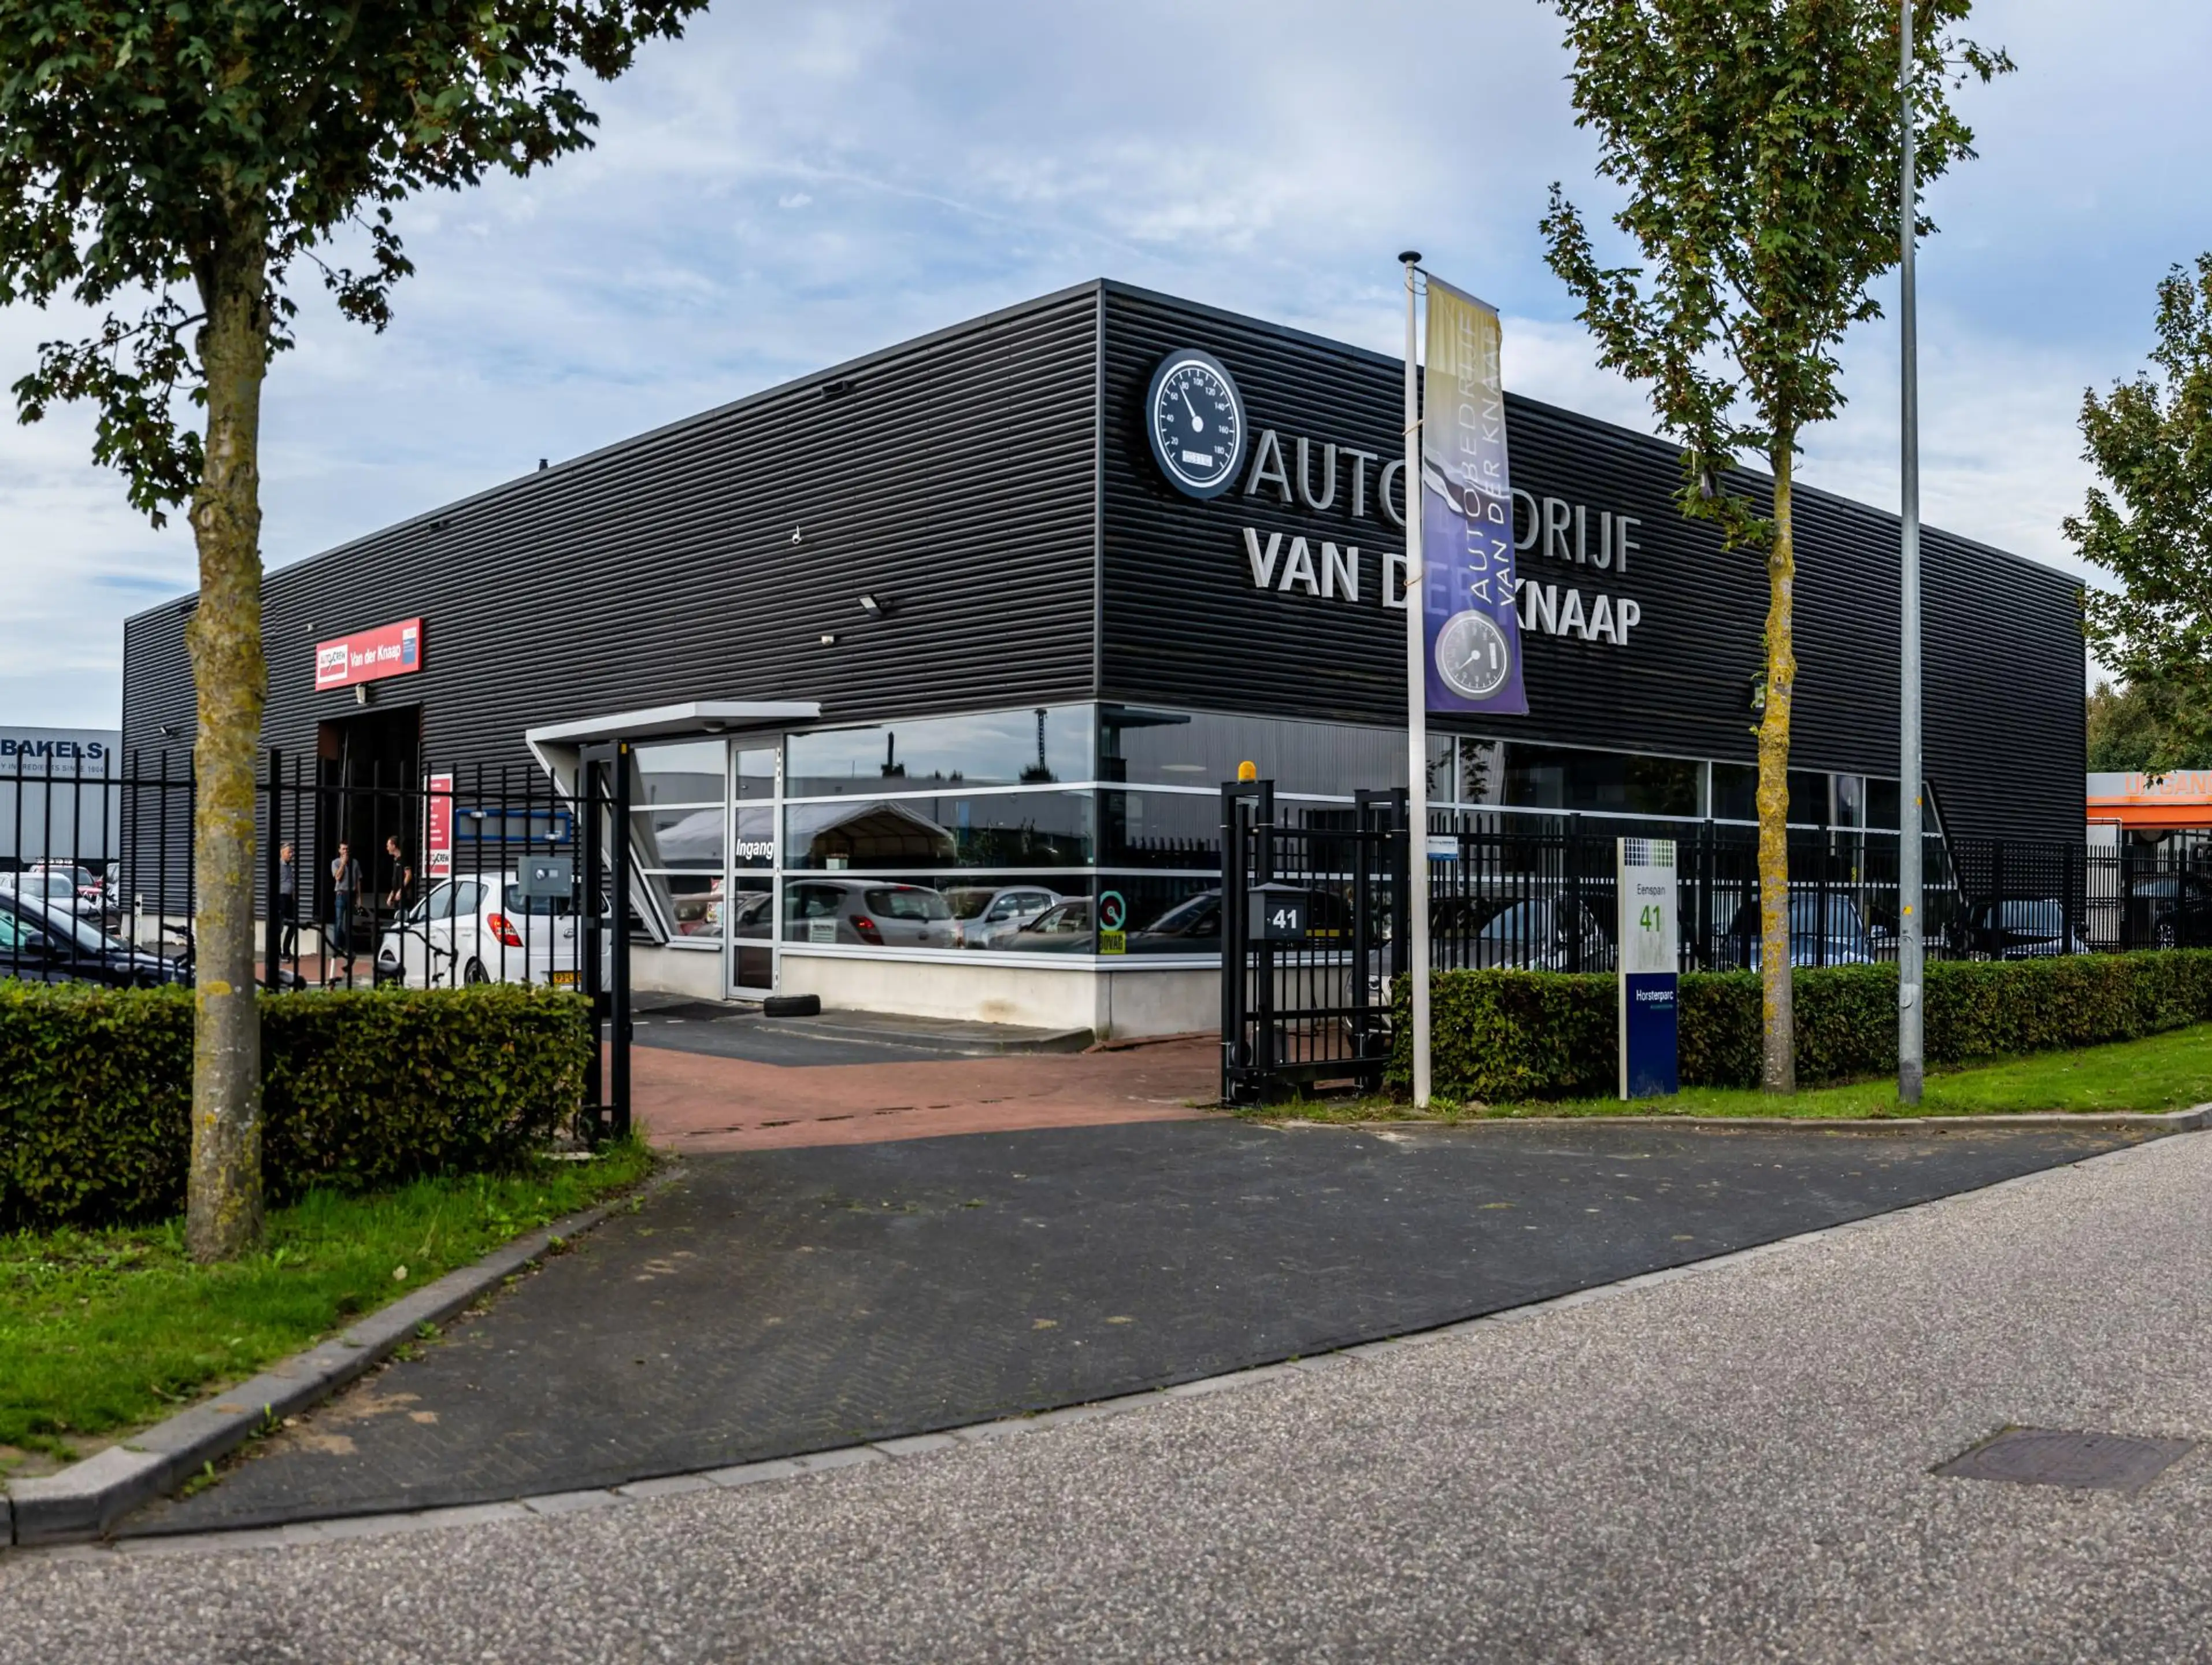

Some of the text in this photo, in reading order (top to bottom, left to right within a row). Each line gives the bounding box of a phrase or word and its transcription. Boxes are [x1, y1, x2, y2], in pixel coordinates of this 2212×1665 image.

[1193, 378, 1204, 387] 100
[1170, 393, 1179, 401] 60
[1205, 387, 1216, 396] 120
[1214, 402, 1225, 411] 140
[1166, 414, 1174, 423] 40
[1218, 425, 1229, 434] 160
[1170, 436, 1179, 445] 20
[1214, 446, 1225, 454] 180
[1481, 326, 1516, 606] VAN DER KNAAP
[1243, 527, 1358, 602] VAN
[350, 651, 364, 667] Van
[364, 648, 376, 663] der
[377, 643, 401, 662] Knaap
[1, 739, 103, 759] BAKELS
[736, 838, 775, 860] Ingang
[1637, 883, 1666, 897] Eenspan
[1273, 909, 1296, 928] 41
[1640, 905, 1660, 932] 41
[1636, 989, 1674, 1002] Horsterparc
